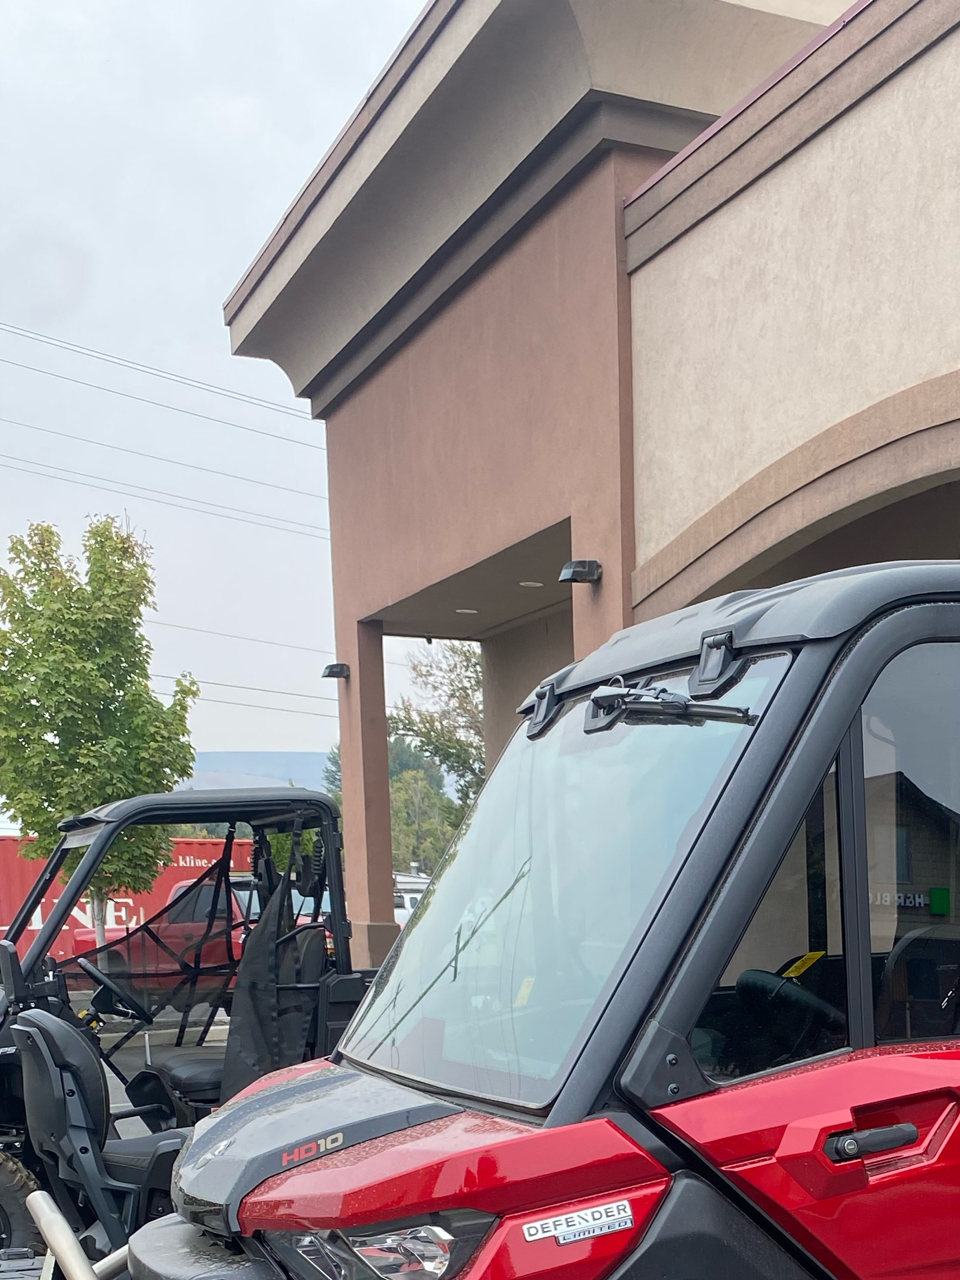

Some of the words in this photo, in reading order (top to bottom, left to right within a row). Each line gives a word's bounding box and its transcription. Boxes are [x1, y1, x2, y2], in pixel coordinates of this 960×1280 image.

[0, 897, 138, 930] INE
[281, 1131, 344, 1167] HD10
[526, 1203, 628, 1238] DEFENDER
[562, 1220, 628, 1242] LIMITED
